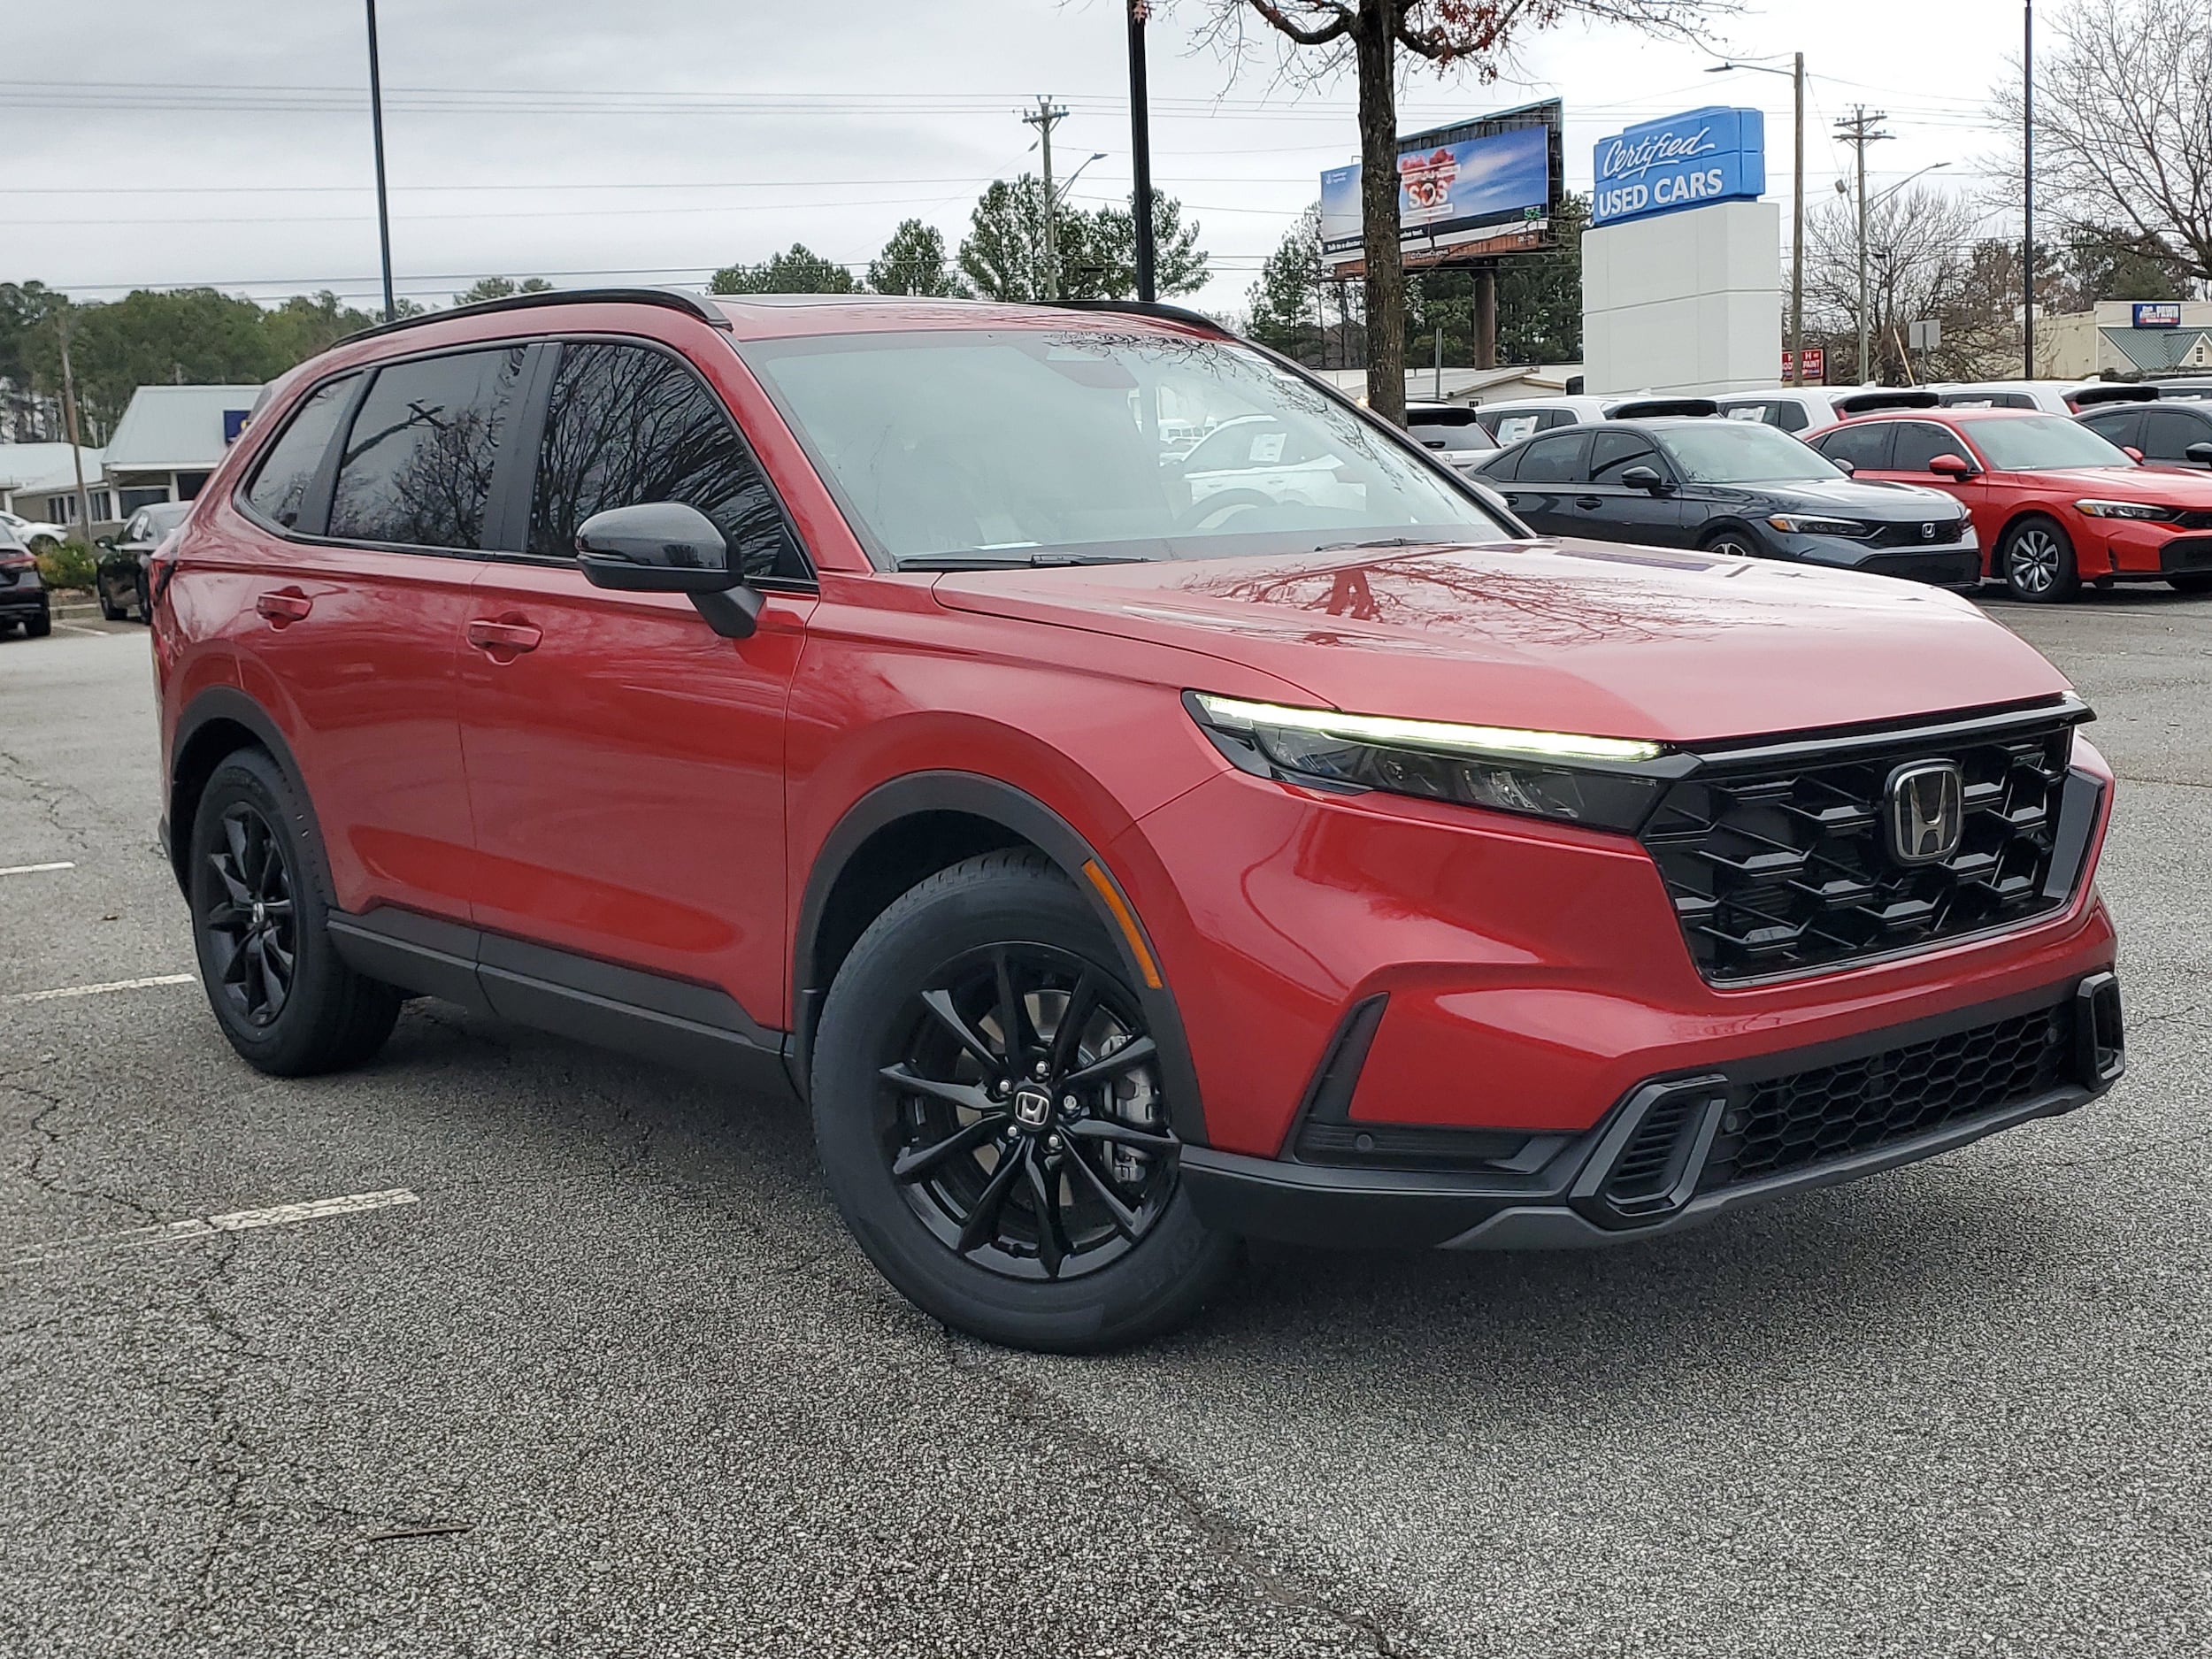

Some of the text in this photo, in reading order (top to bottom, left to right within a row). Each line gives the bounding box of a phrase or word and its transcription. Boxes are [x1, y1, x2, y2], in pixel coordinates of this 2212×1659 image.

[1603, 127, 1715, 178] Certified
[1599, 168, 1723, 218] USED CARS
